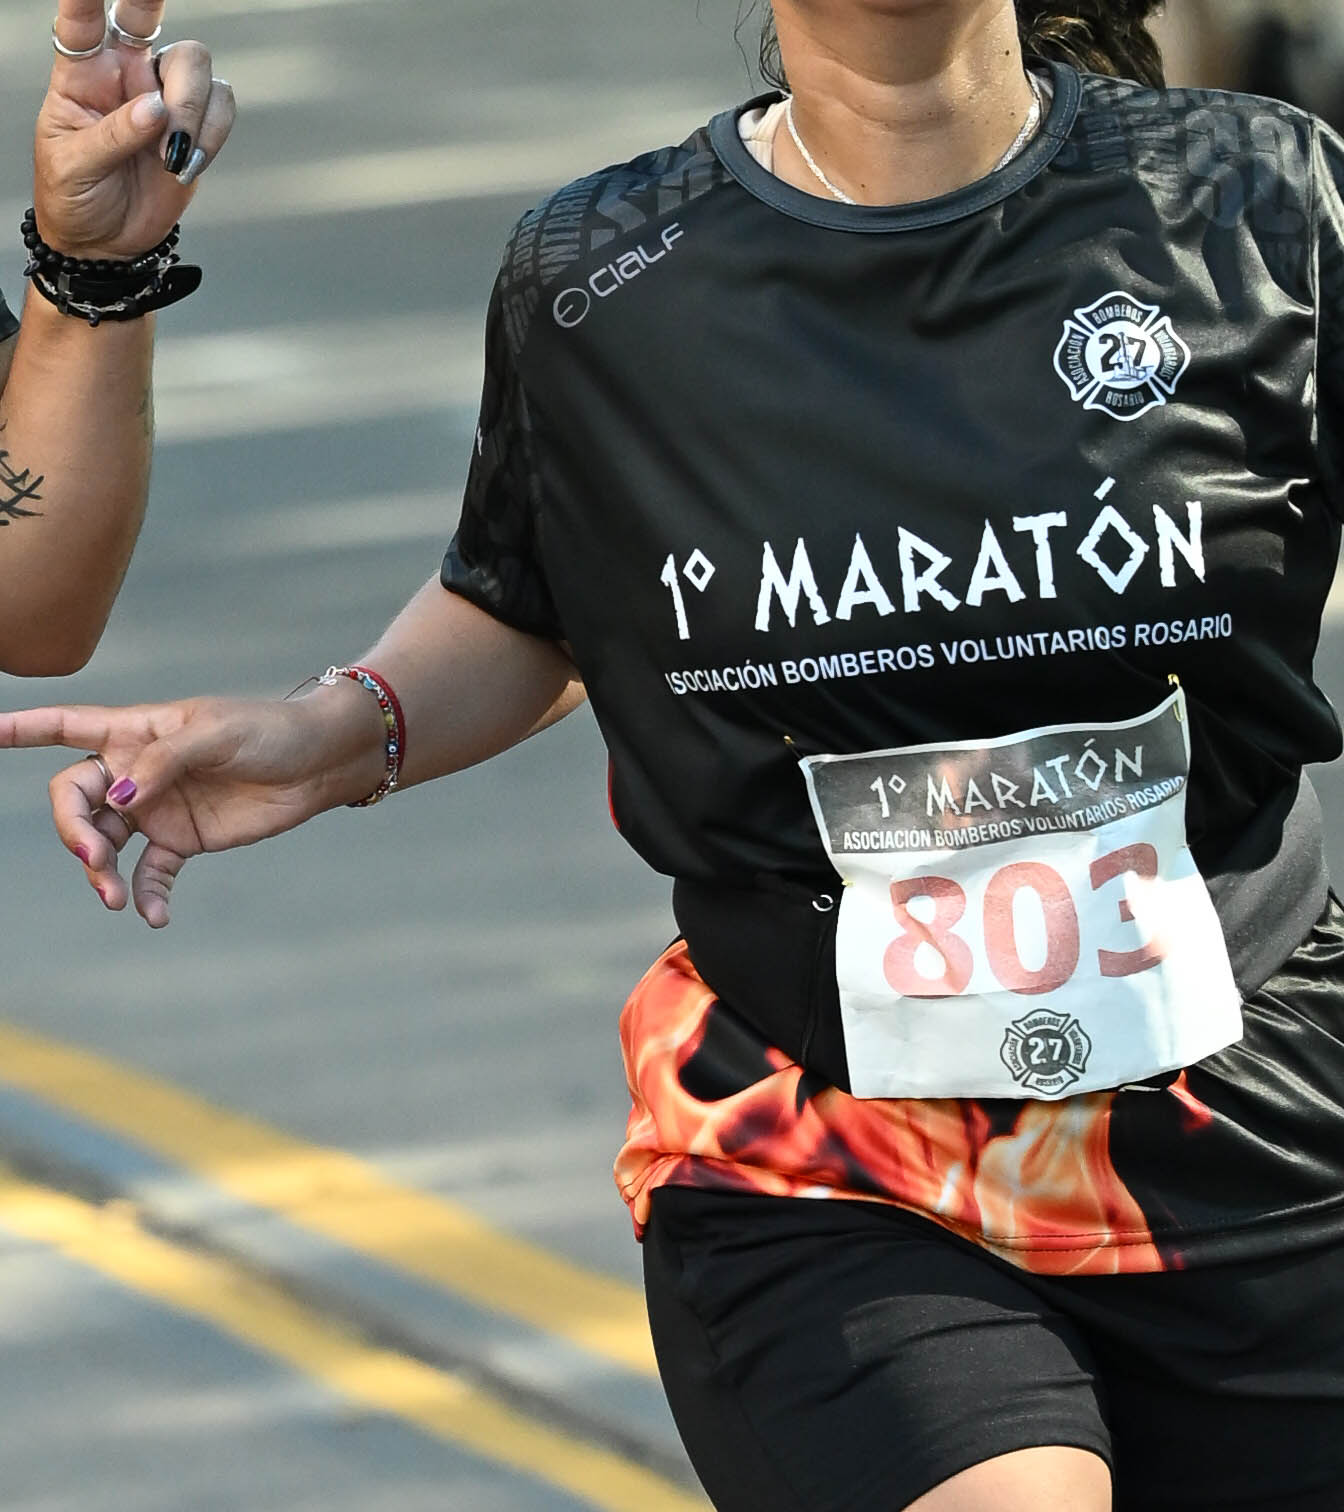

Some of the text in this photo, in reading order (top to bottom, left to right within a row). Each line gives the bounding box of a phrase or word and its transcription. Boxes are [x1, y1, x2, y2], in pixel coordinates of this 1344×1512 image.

[1092, 303, 1144, 324] BOMBEROS
[1098, 333, 1146, 373] 27
[1105, 390, 1145, 408] ROSARIO
[755, 476, 1205, 632] MARATÓN
[781, 644, 935, 685] BOMBEROS
[940, 625, 1127, 665] VOLUNTARIOS
[1134, 613, 1232, 647] ROSARIO
[843, 775, 1185, 850] ASOCIACIÓN BOMBEROS VOLUNTARIOS ROSARIO
[926, 738, 1143, 817] MARATÓN
[882, 842, 1167, 1000] 803
[1028, 1037, 1063, 1065] 27
